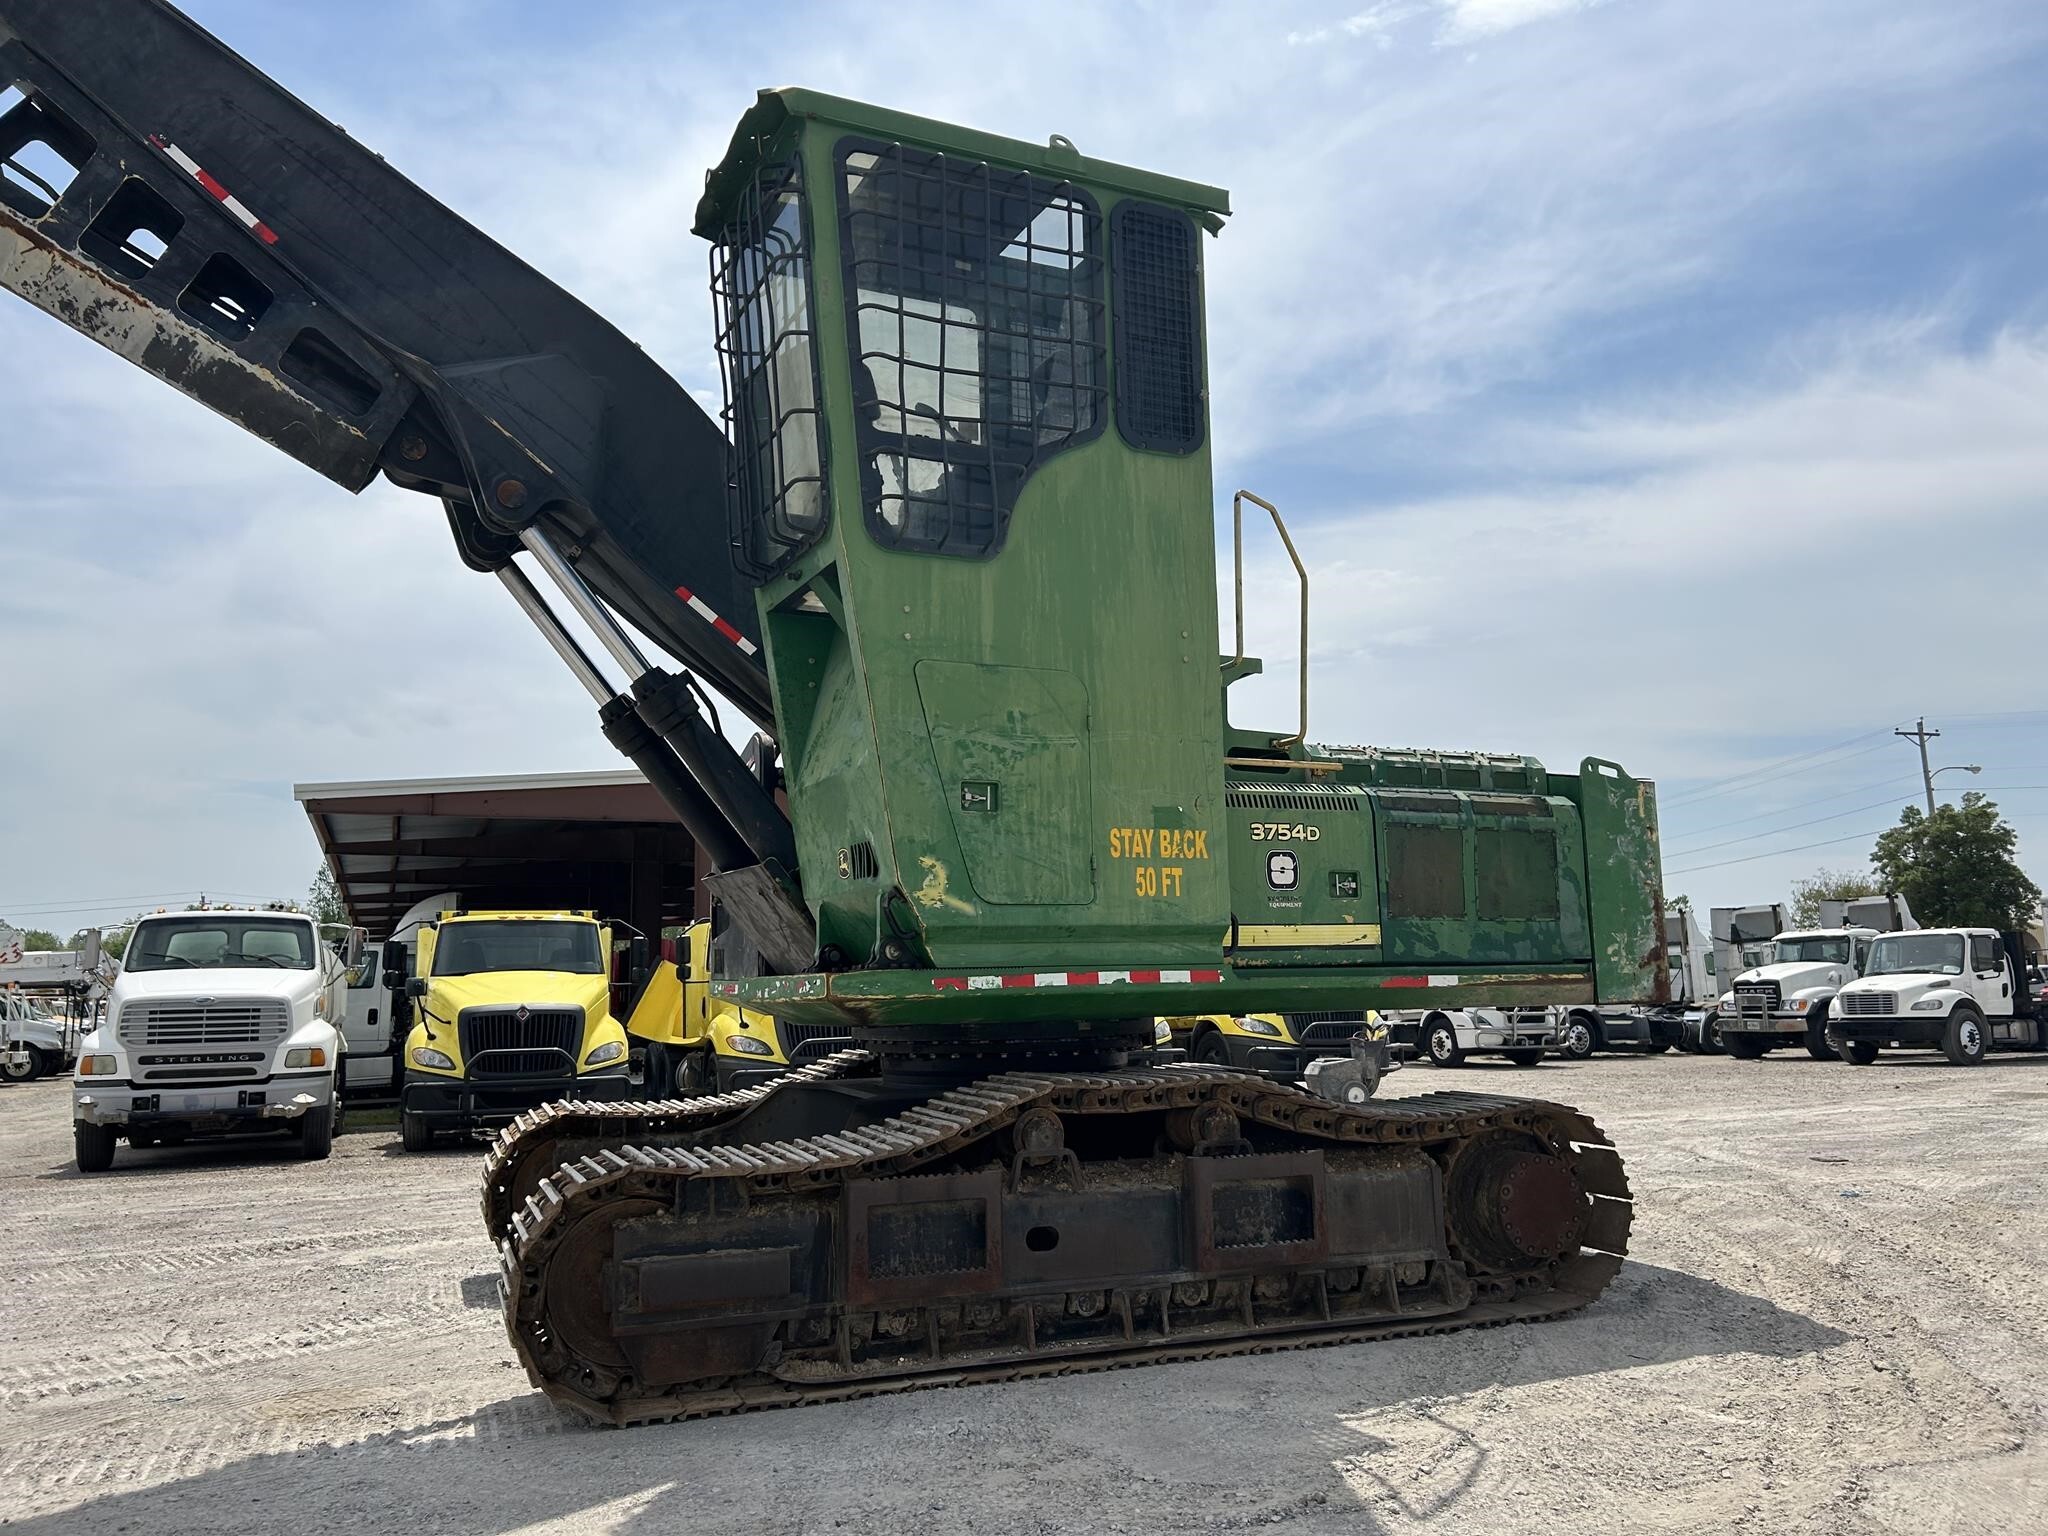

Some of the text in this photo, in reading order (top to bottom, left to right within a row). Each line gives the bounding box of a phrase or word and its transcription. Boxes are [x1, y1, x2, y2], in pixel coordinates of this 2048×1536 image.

[1110, 827, 1209, 859] STAY BACK
[1250, 822, 1321, 841] 3754D
[1136, 866, 1183, 897] 50 FT
[154, 1055, 250, 1063] STERLING
